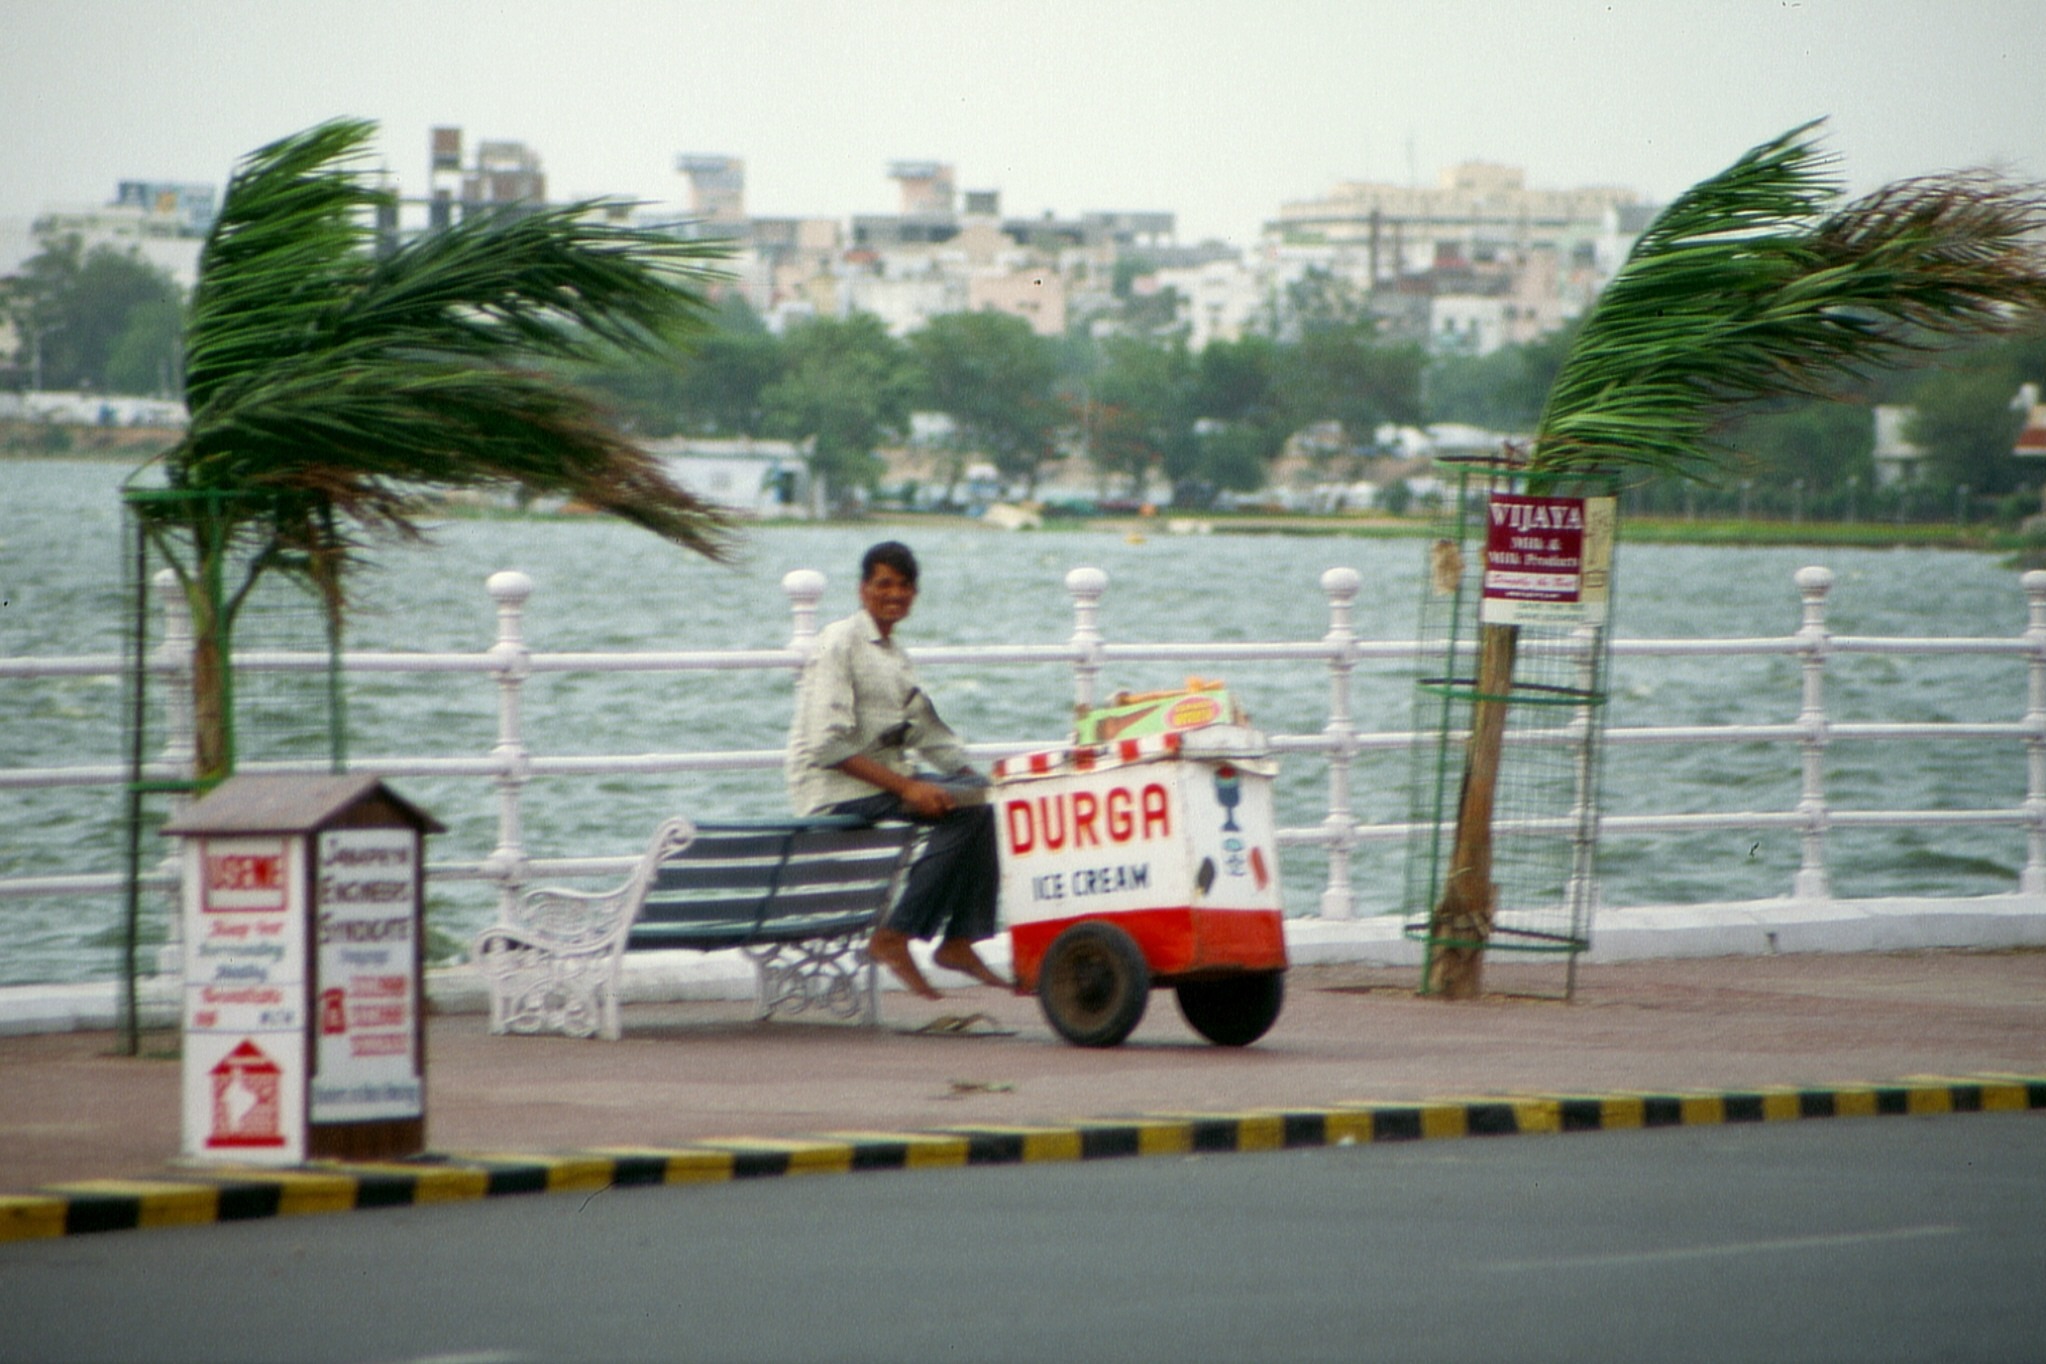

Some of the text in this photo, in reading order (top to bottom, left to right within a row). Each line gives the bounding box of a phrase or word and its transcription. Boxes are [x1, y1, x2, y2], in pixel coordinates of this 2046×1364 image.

[1489, 502, 1584, 532] VIJAYA
[1006, 782, 1170, 856] DURGA
[1032, 862, 1151, 901] ICE CREAM
